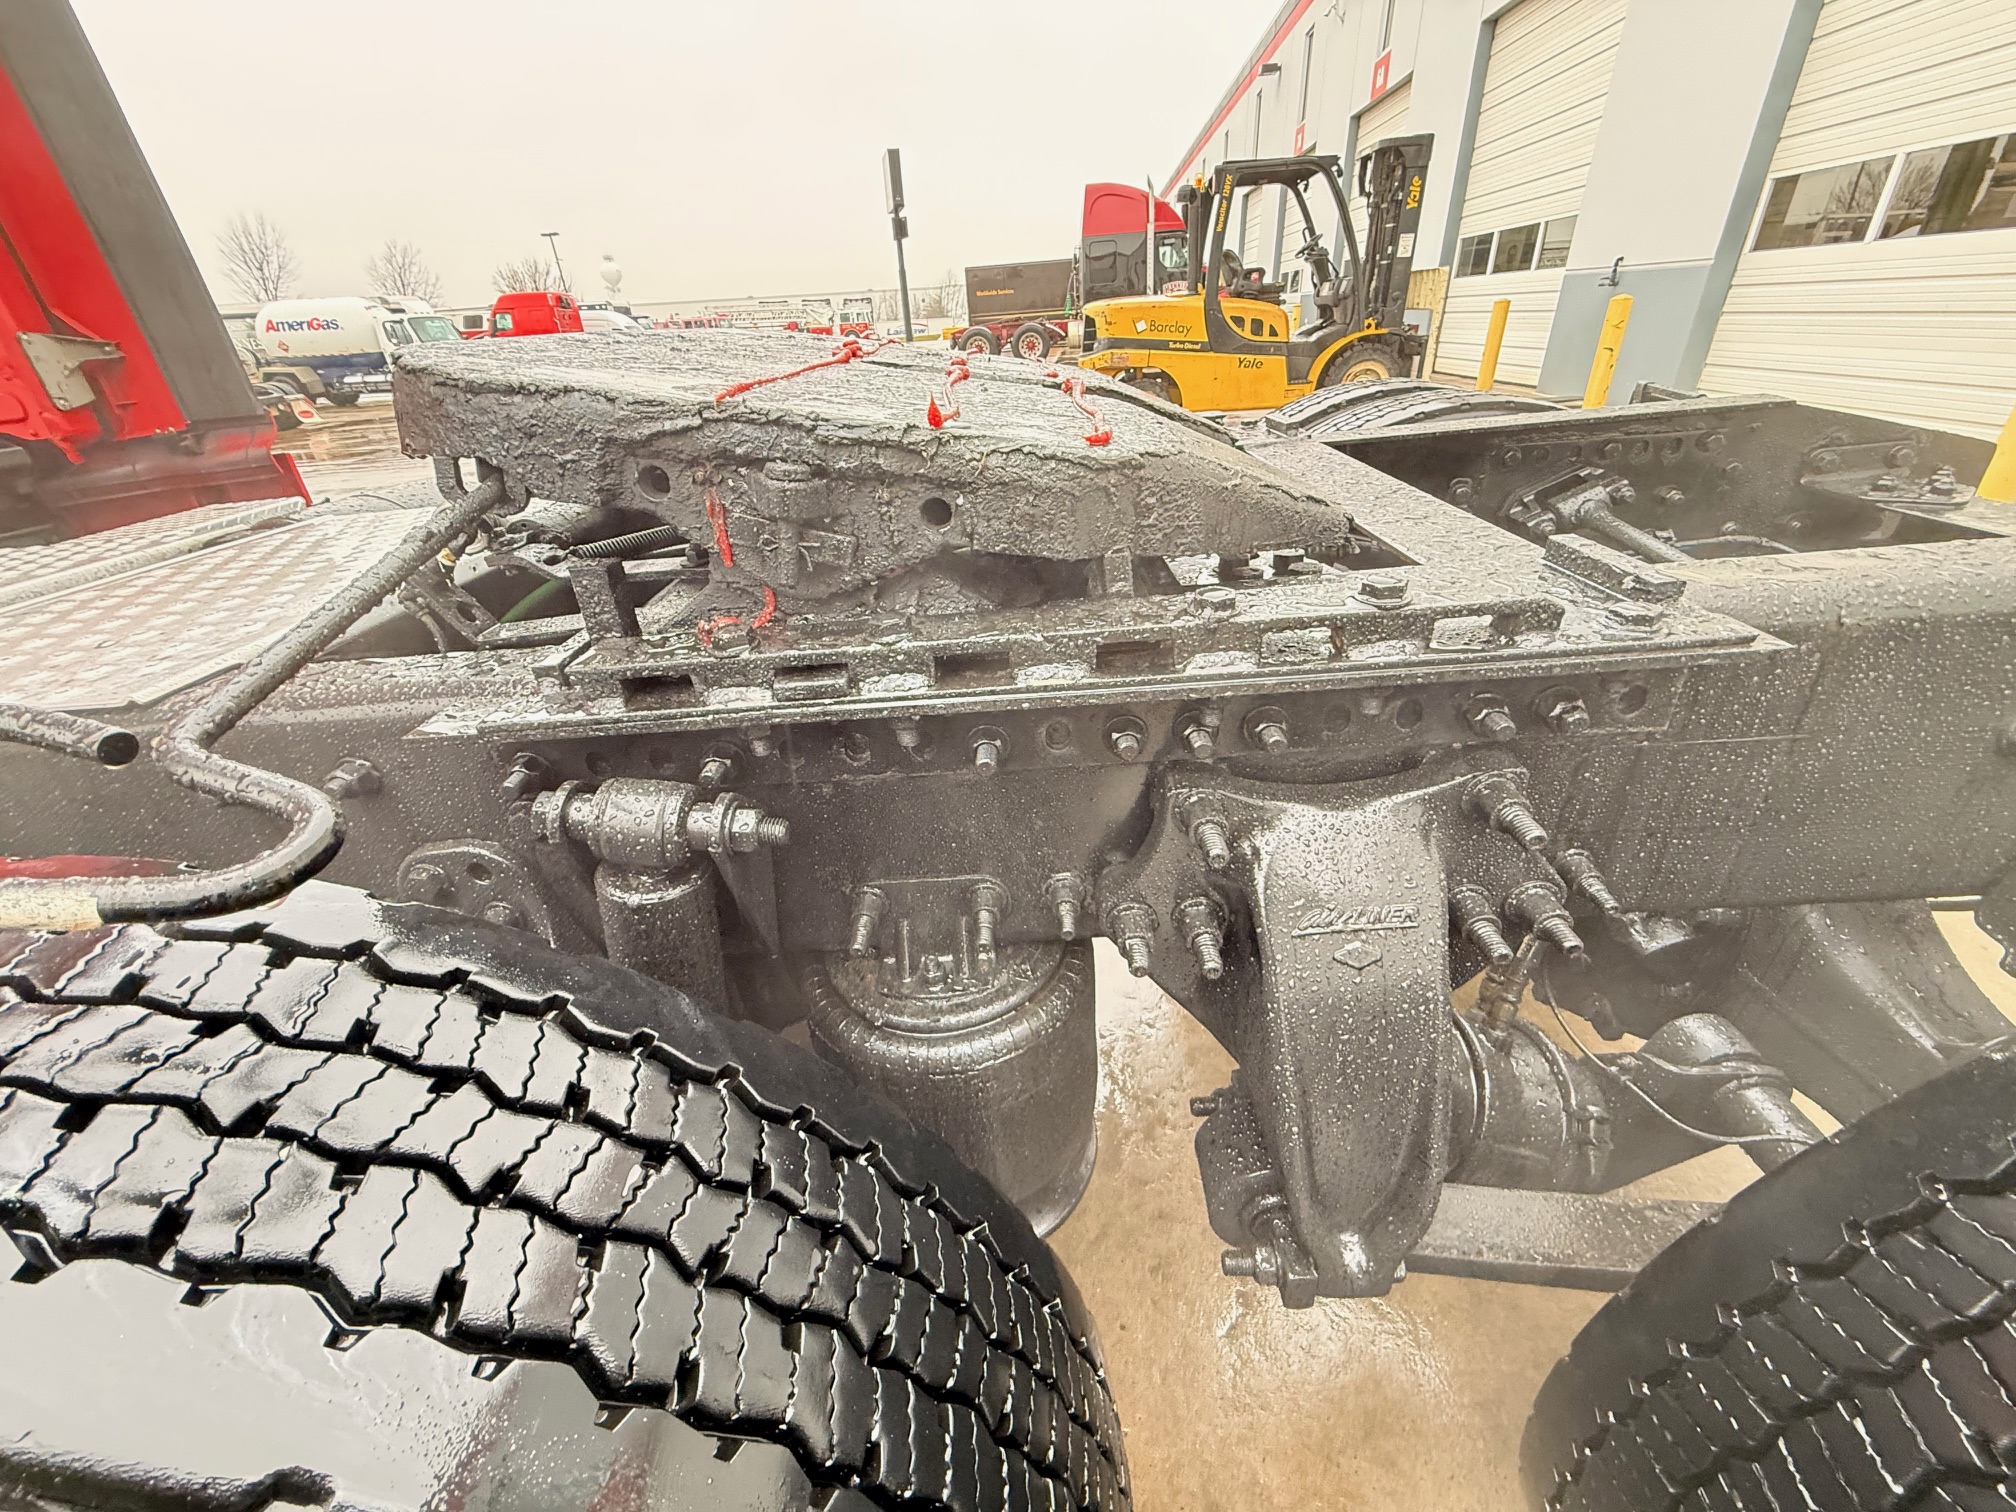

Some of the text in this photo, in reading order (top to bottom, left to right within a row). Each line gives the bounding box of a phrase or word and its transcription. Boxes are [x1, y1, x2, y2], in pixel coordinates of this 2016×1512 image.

[1406, 175, 1422, 210] Yale
[1215, 173, 1233, 232] Veracitor 120VX
[265, 317, 339, 333] AmeriGas
[1149, 319, 1192, 338] Barclay
[1237, 356, 1264, 369] Yale
